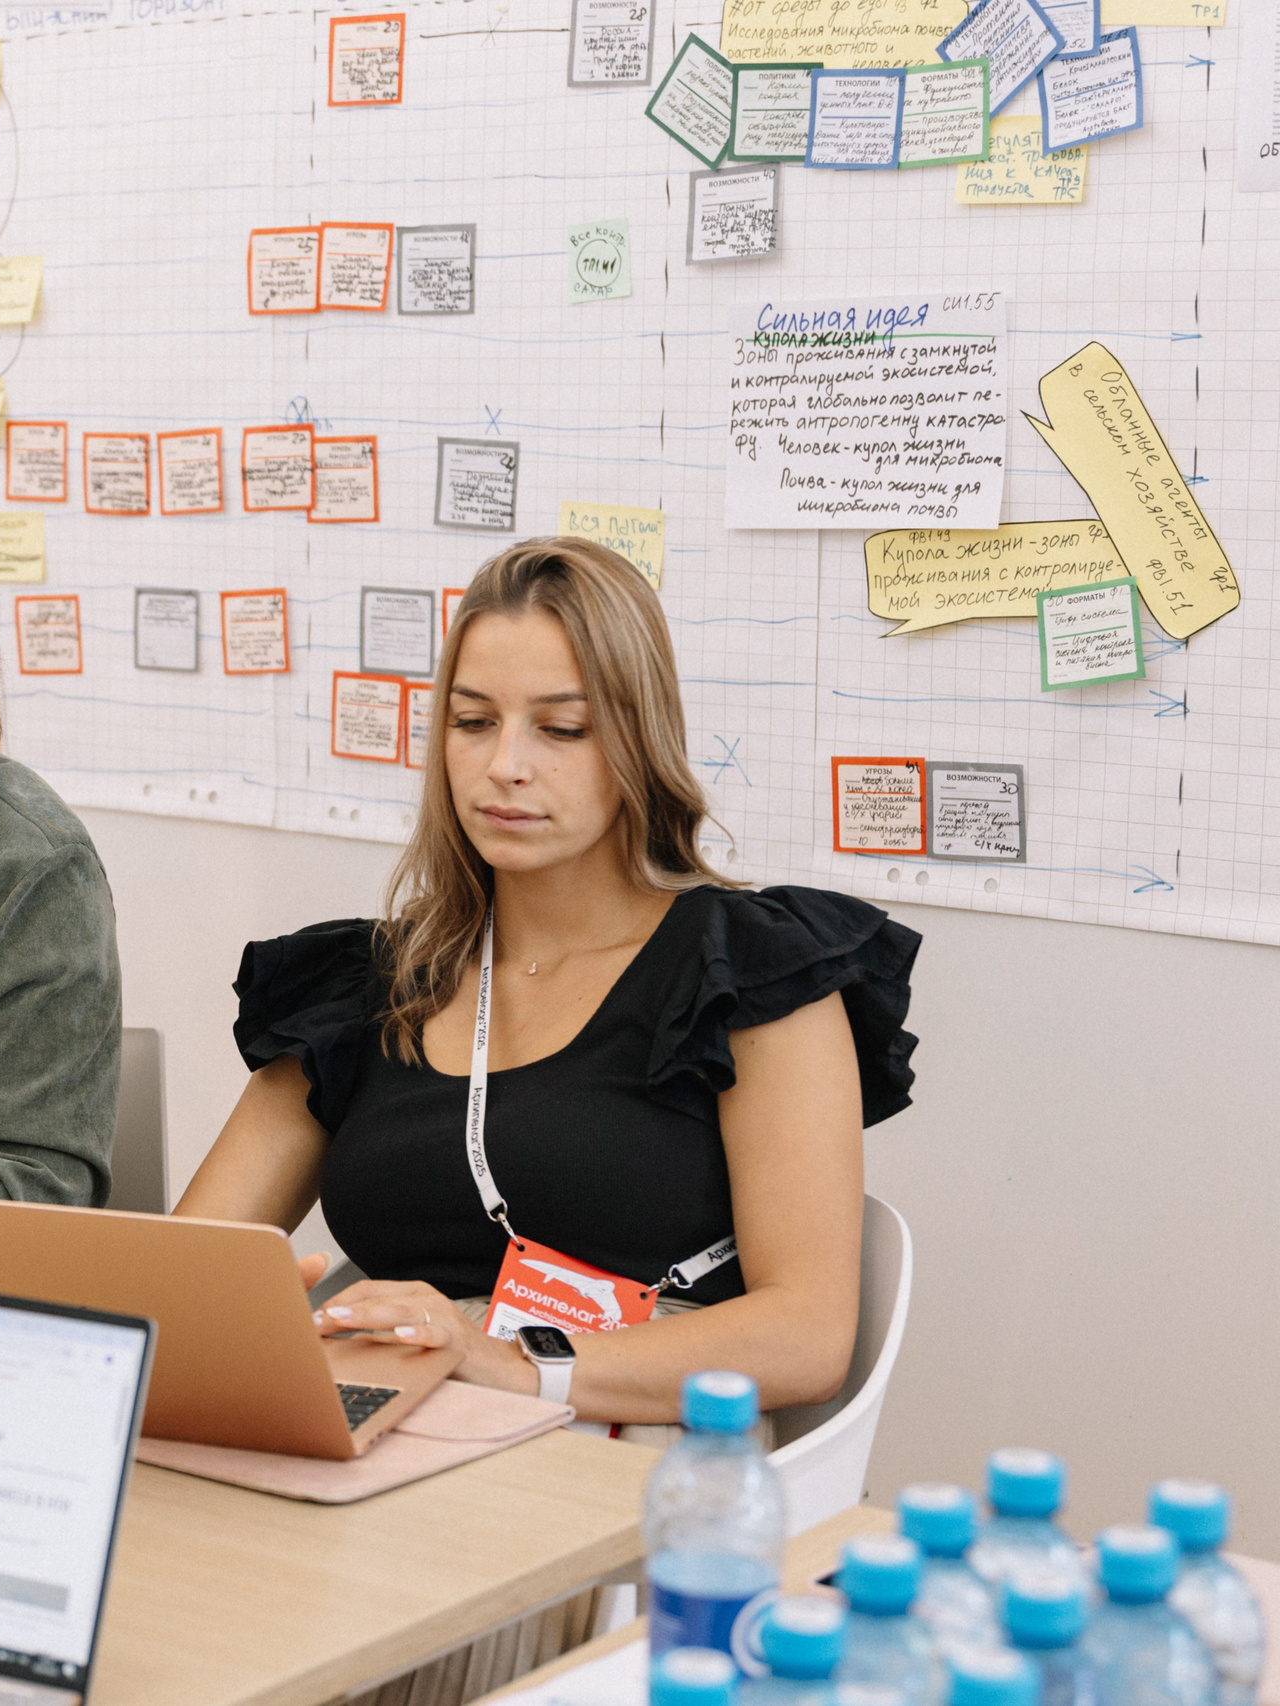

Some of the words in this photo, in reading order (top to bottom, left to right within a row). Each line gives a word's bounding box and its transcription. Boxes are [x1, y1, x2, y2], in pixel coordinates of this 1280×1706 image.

[629, 7, 647, 21] 28
[728, 23, 824, 47] Исследования
[831, 21, 909, 40] микробиома
[704, 57, 734, 84] ПОЛИТИК
[921, 73, 959, 82] ФОРМАТЫ
[708, 176, 760, 188] ВОЗМОЖНОСТИ
[763, 169, 776, 180] 40
[757, 303, 856, 332] Сильная
[866, 303, 929, 355] идея
[734, 338, 778, 366] Зоны
[786, 346, 895, 373] проживания
[909, 338, 997, 367] замкнутой
[732, 397, 797, 416] которая
[807, 395, 888, 411] глобально
[890, 390, 968, 411] позволит
[730, 417, 790, 435] режить
[903, 438, 966, 458] жизни
[875, 454, 900, 474] для
[905, 452, 1003, 474] микробиома
[1083, 387, 1131, 456] сельском
[1126, 467, 1195, 573] хозяйстве
[888, 481, 948, 499] жизни
[954, 481, 981, 502] для
[797, 498, 901, 519] микробиома
[907, 504, 958, 519] почвы
[1161, 477, 1207, 540] агенты
[883, 538, 950, 569] Купола
[955, 535, 1022, 560] жизни
[874, 566, 991, 593] проживания
[1067, 593, 1106, 604] ФОРМАТЫ
[946, 774, 1002, 783] ВОЗМОЖНОСТИ
[999, 782, 1019, 794] 30
